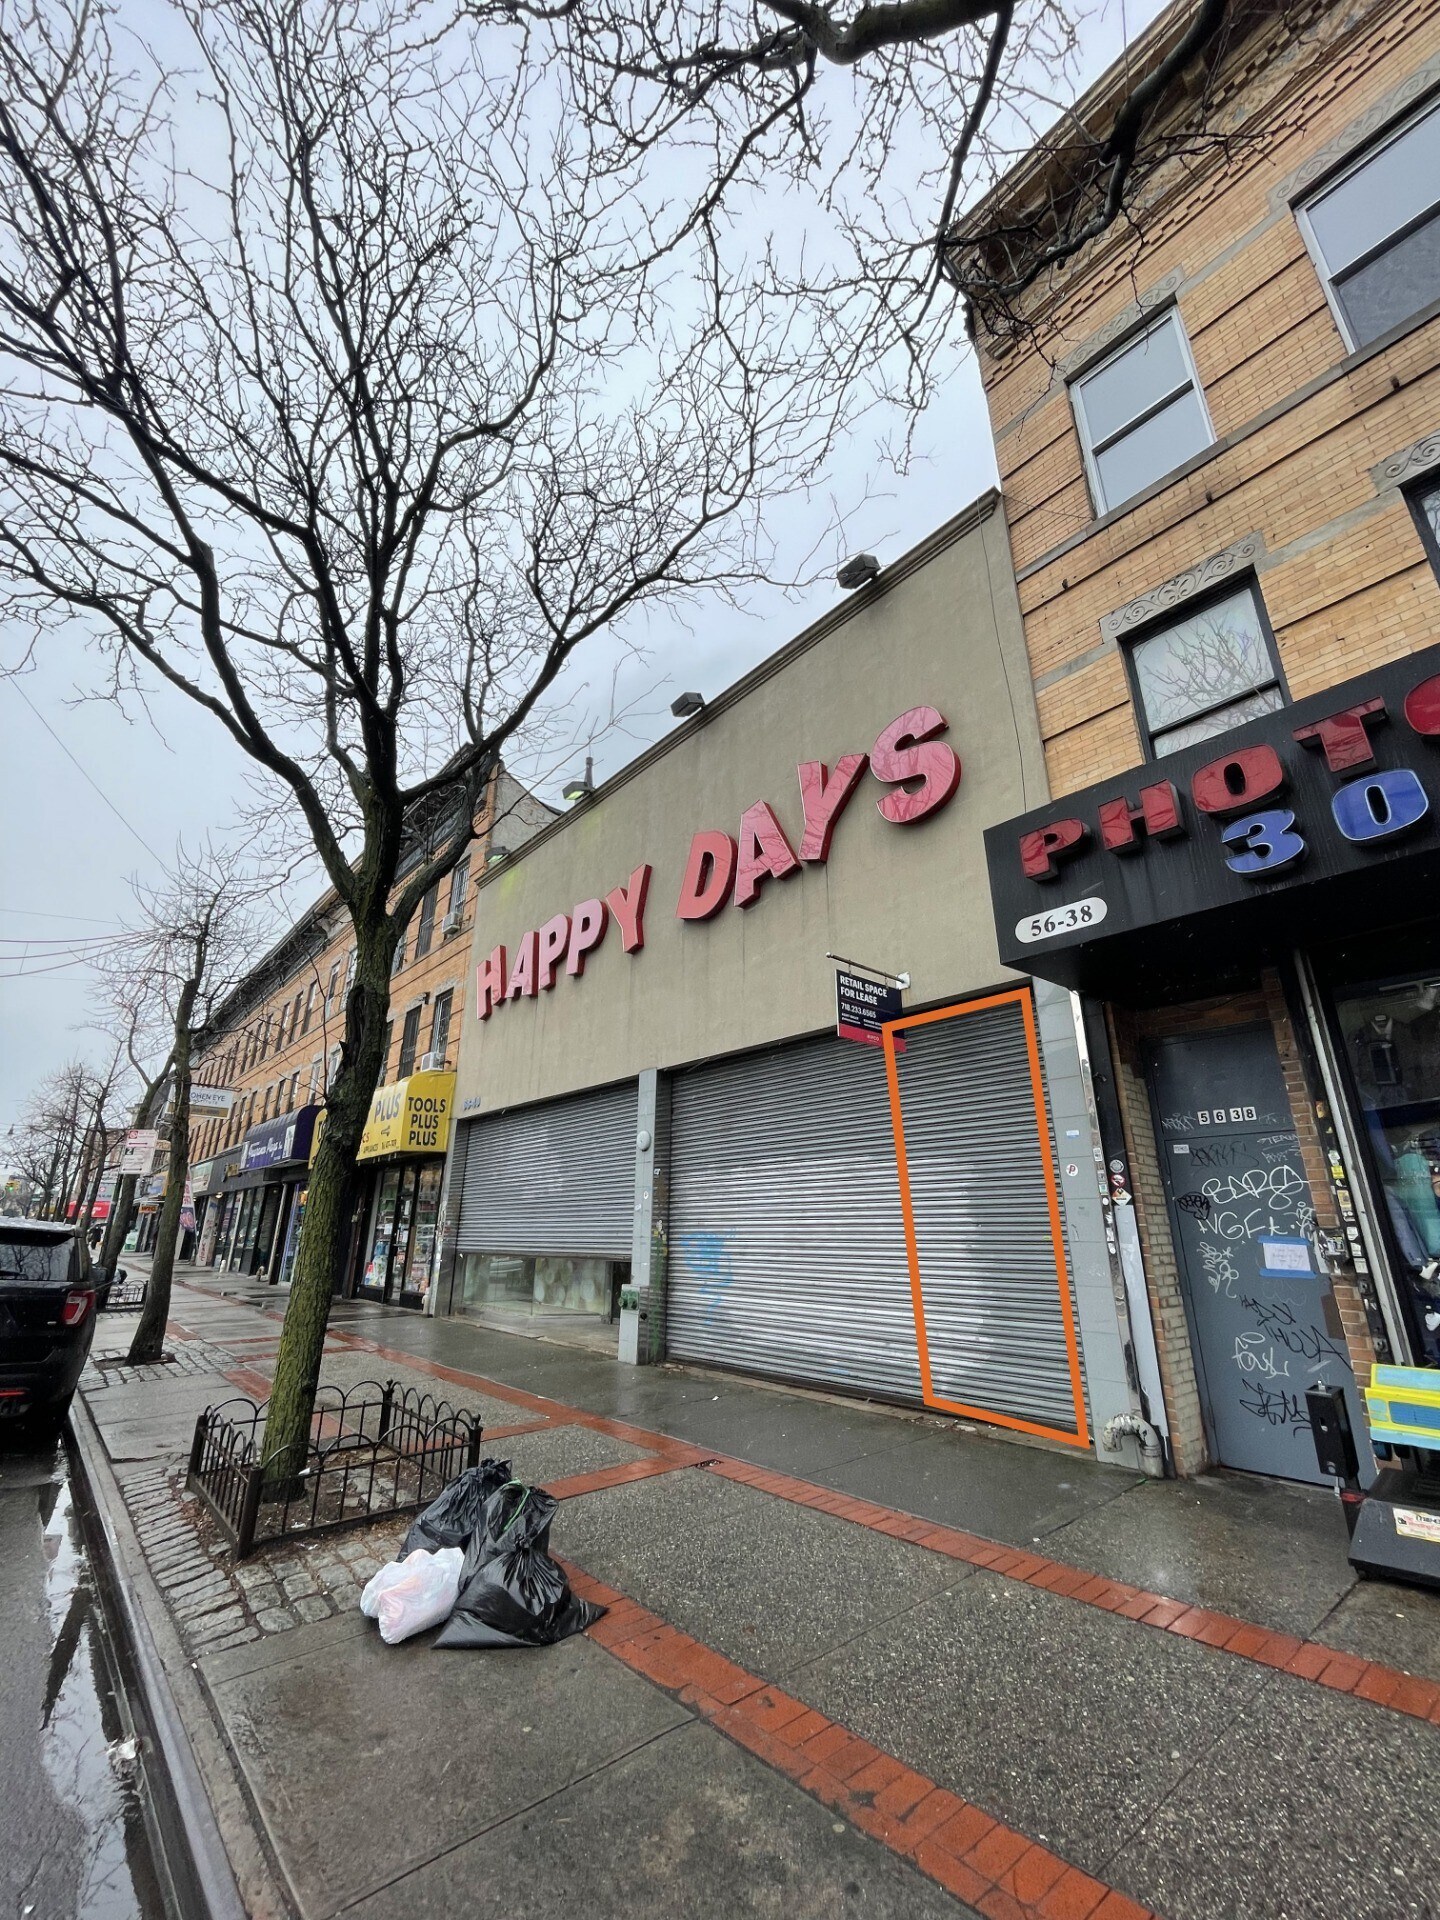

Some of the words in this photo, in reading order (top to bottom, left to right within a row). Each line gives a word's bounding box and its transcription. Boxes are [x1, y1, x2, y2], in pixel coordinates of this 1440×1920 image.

[1220, 767, 1432, 880] 30
[476, 863, 653, 1022] HAPPY
[675, 704, 962, 921] DAYS
[1029, 903, 1095, 938] 56-38
[840, 975, 864, 991] RETAIL
[864, 983, 888, 998] SPACE
[840, 986, 856, 999] FOR
[855, 992, 878, 1006] LEASE
[190, 1091, 211, 1100] OHEN
[407, 1096, 447, 1113] TOOLS
[374, 1093, 401, 1124] PLUS
[410, 1113, 439, 1130] PLUS
[408, 1130, 437, 1147] PLUS
